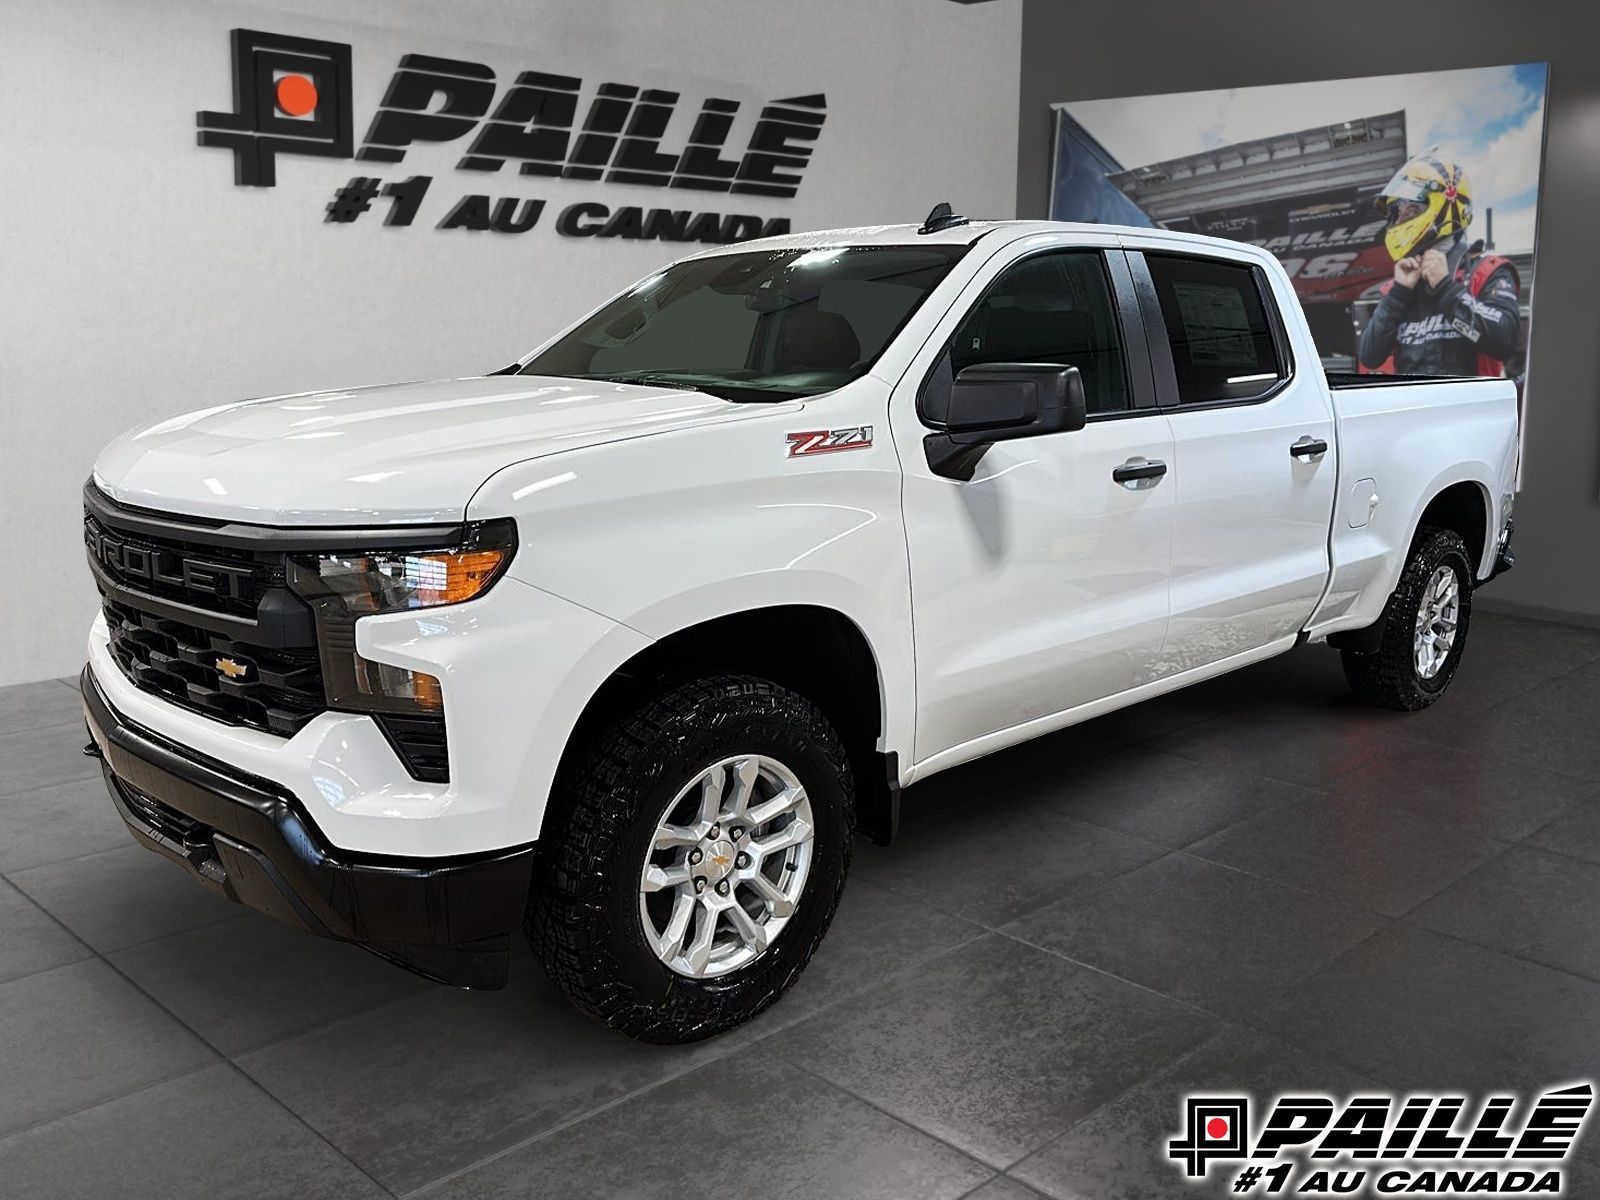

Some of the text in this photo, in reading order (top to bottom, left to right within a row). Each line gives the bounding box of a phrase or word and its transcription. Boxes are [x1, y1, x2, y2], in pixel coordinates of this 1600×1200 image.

[355, 53, 828, 198] PAILLÉ
[323, 175, 791, 245] #1 AU CANADA
[785, 425, 873, 458] Z71
